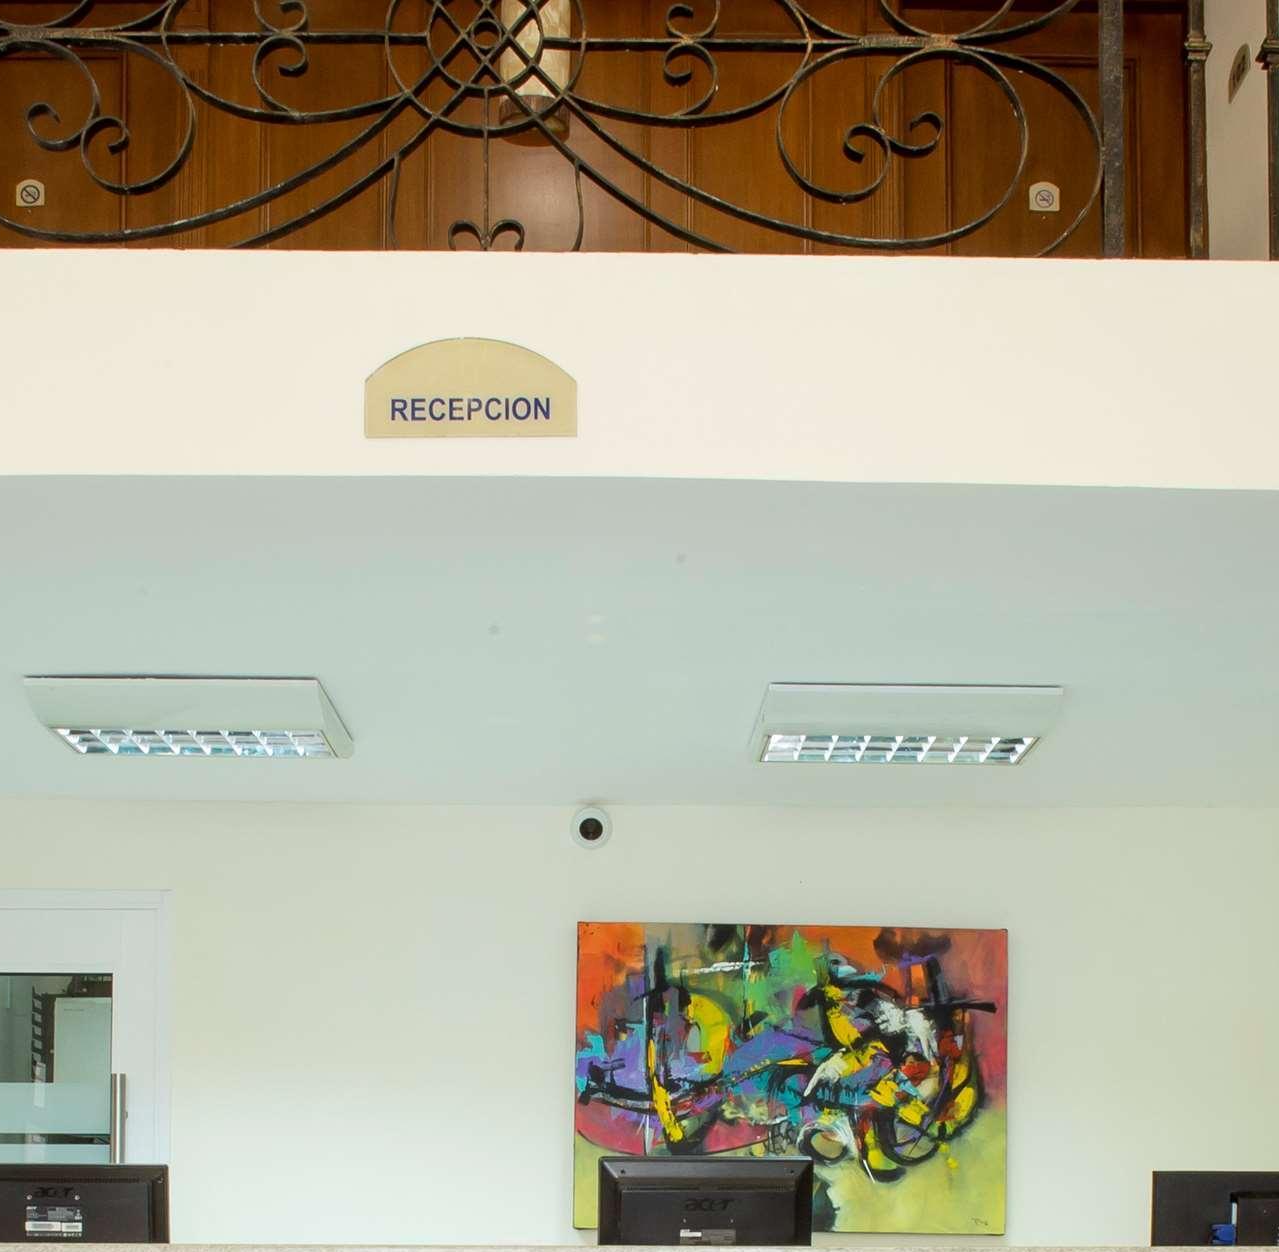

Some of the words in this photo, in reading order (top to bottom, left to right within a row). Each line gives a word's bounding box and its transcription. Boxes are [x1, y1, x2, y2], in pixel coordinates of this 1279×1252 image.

[391, 397, 551, 422] RECEPCION
[34, 1186, 74, 1199] acer
[684, 1199, 735, 1212] acer
